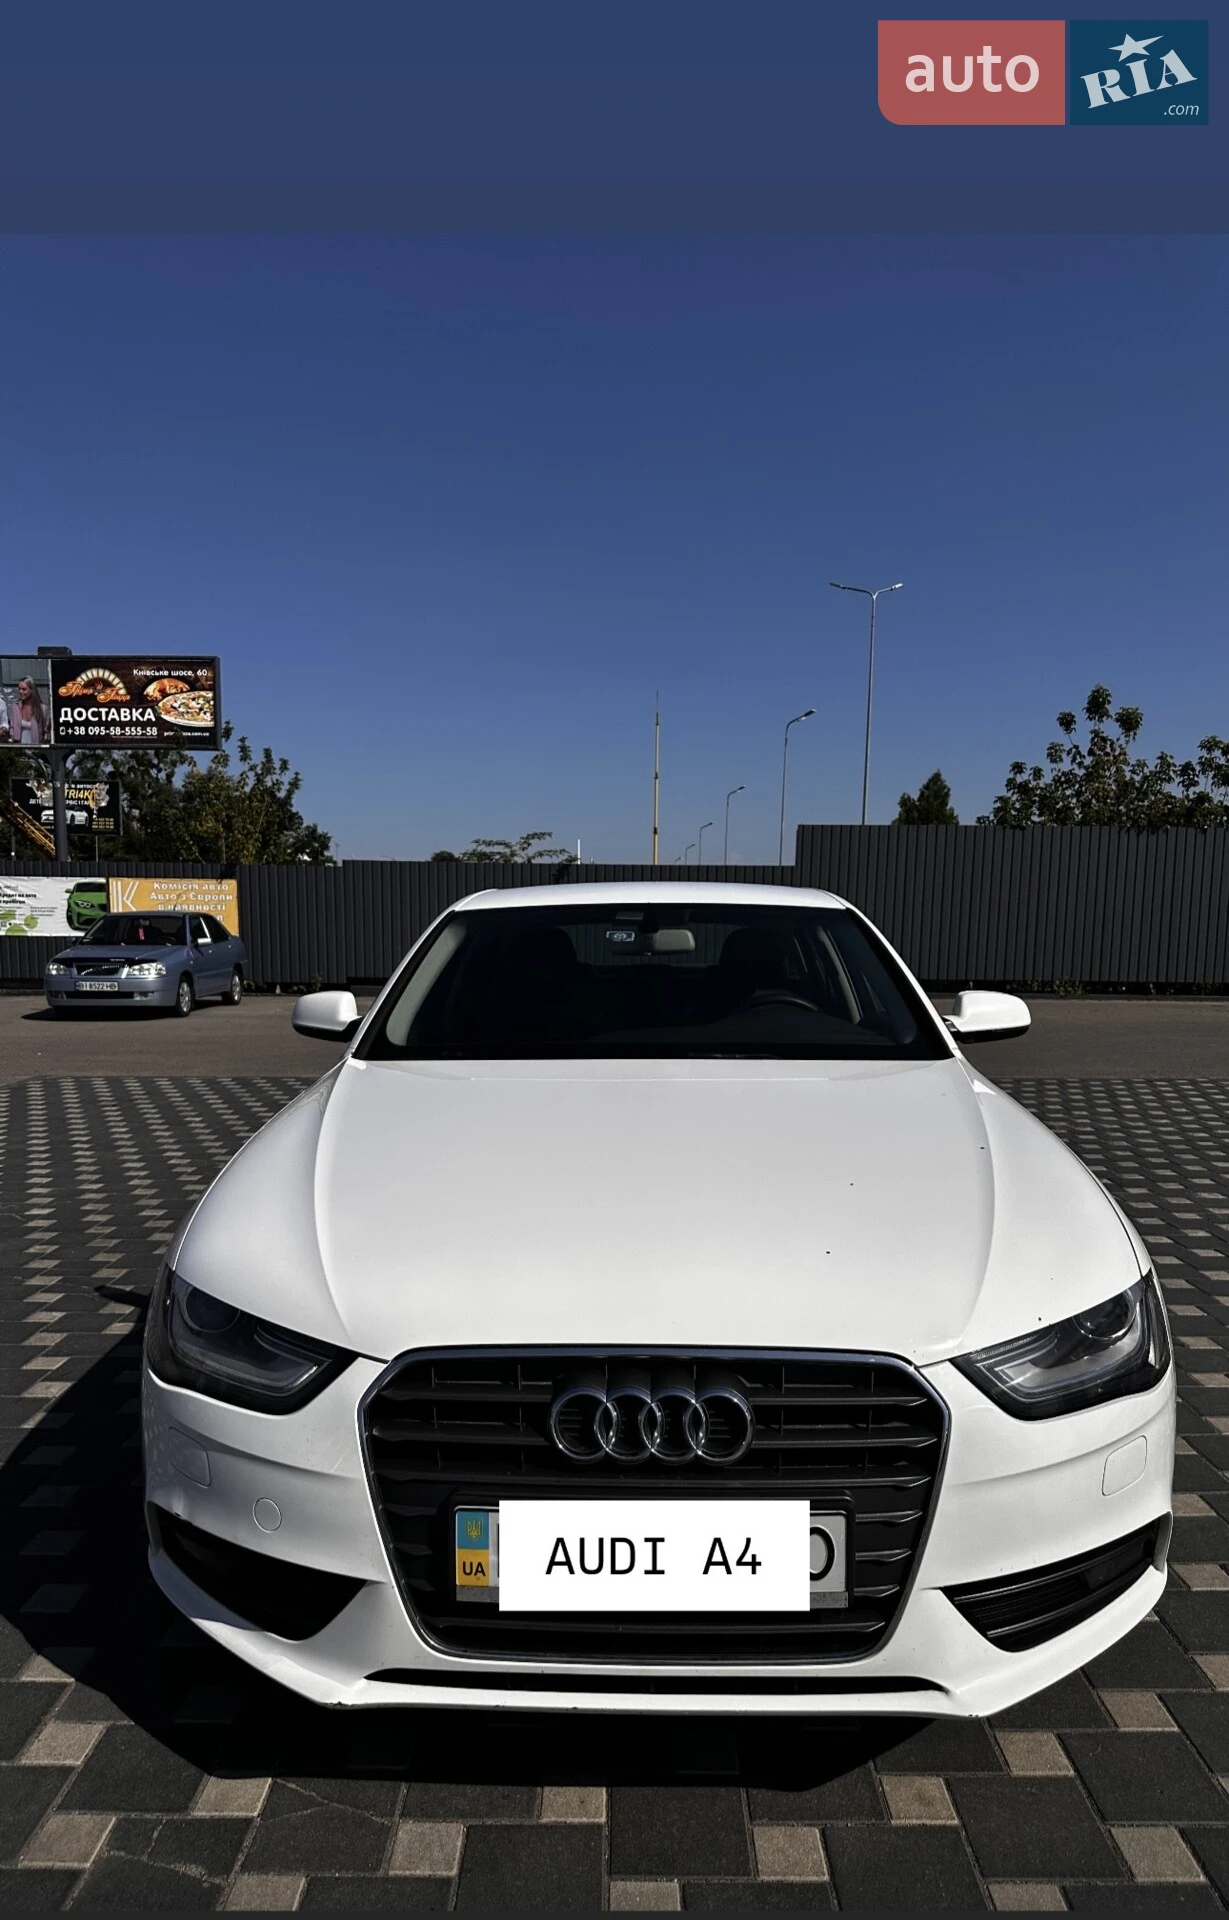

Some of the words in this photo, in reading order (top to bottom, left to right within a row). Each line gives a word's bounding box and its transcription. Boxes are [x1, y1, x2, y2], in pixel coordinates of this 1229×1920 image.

[133, 669, 169, 677] Київське
[59, 707, 156, 723] ДОСТАВКА
[67, 727, 86, 736] +38
[88, 726, 158, 736] 095-58-555-58
[153, 881, 199, 890] Комісія
[202, 882, 229, 890] авто
[150, 892, 177, 900] Авто
[189, 892, 233, 902] Європи
[168, 903, 226, 911] наявності
[462, 1560, 486, 1577] UA
